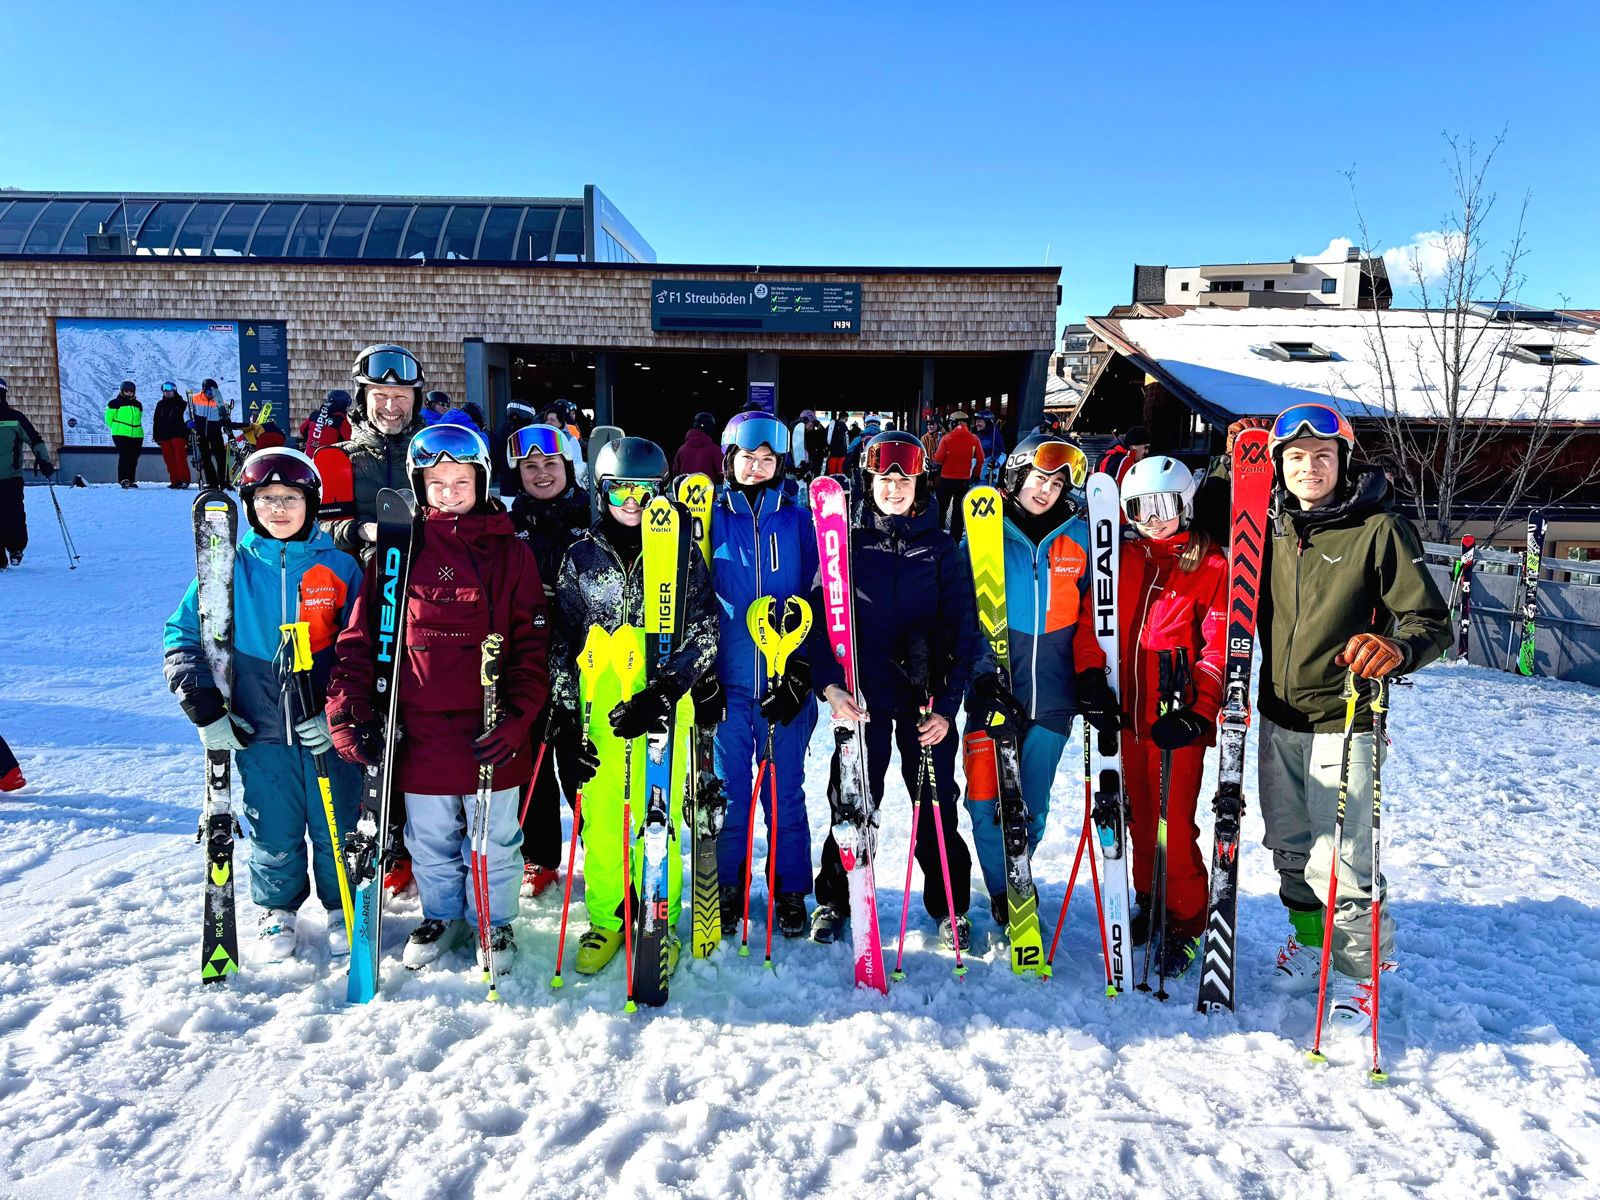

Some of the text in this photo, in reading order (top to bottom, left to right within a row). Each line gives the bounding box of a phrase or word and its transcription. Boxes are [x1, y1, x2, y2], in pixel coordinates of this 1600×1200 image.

[670, 292, 681, 303] F1
[685, 292, 746, 304] Streuböden
[833, 321, 851, 329] 1434
[825, 529, 846, 632] HEAD
[1096, 518, 1115, 637] HEAD
[377, 547, 401, 663] HEAD
[659, 582, 671, 667] ACETIGER
[758, 618, 768, 645] LEKI
[795, 620, 810, 646] LEKI
[1230, 638, 1251, 650] GS
[626, 650, 635, 670] LEKI
[1336, 780, 1348, 818] LEKI
[1372, 779, 1381, 817] LEKI
[215, 922, 224, 938] RC4
[700, 941, 716, 958] 12
[1014, 945, 1040, 966] 12
[1112, 923, 1124, 994] HEAD
